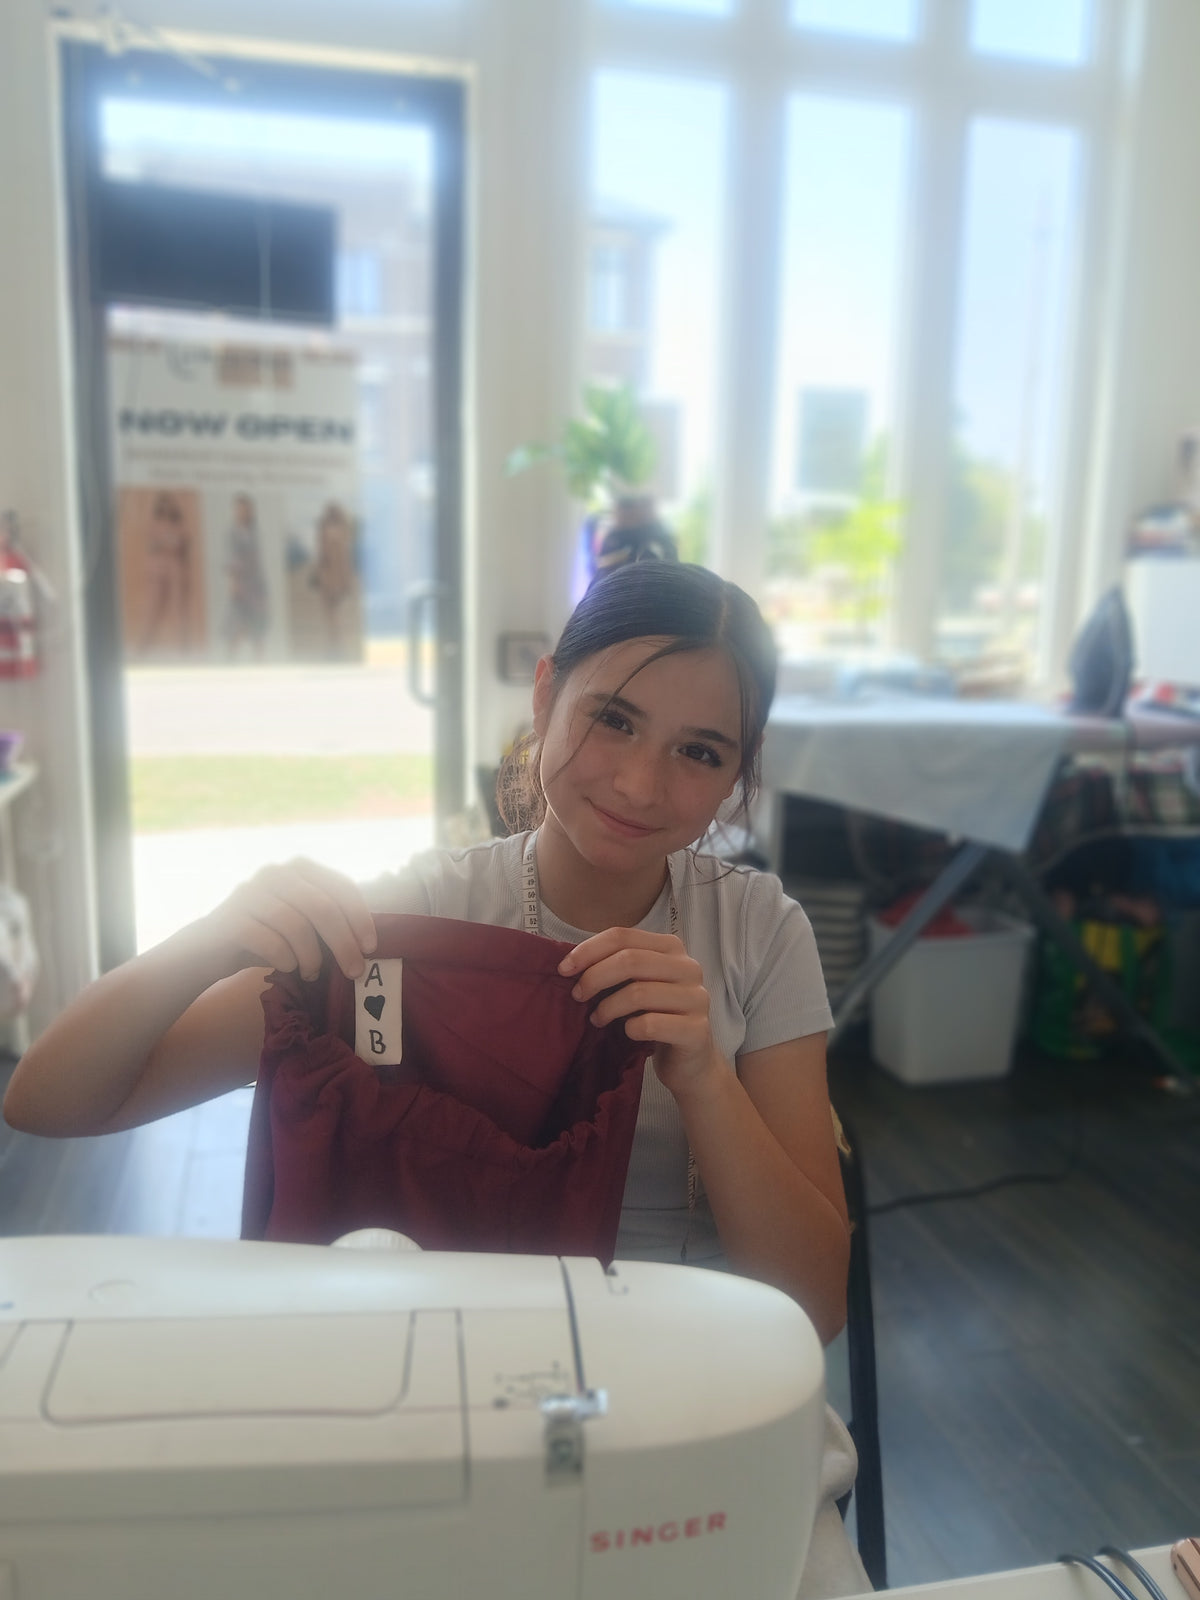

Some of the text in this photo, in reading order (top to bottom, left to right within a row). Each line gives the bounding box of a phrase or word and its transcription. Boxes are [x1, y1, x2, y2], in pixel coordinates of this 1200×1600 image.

[119, 408, 355, 442] NOW OPEN
[528, 904, 536, 912] 51
[529, 917, 537, 925] 52
[364, 962, 383, 988] A
[369, 1029, 386, 1054] B
[589, 1510, 727, 1553] SINGER
